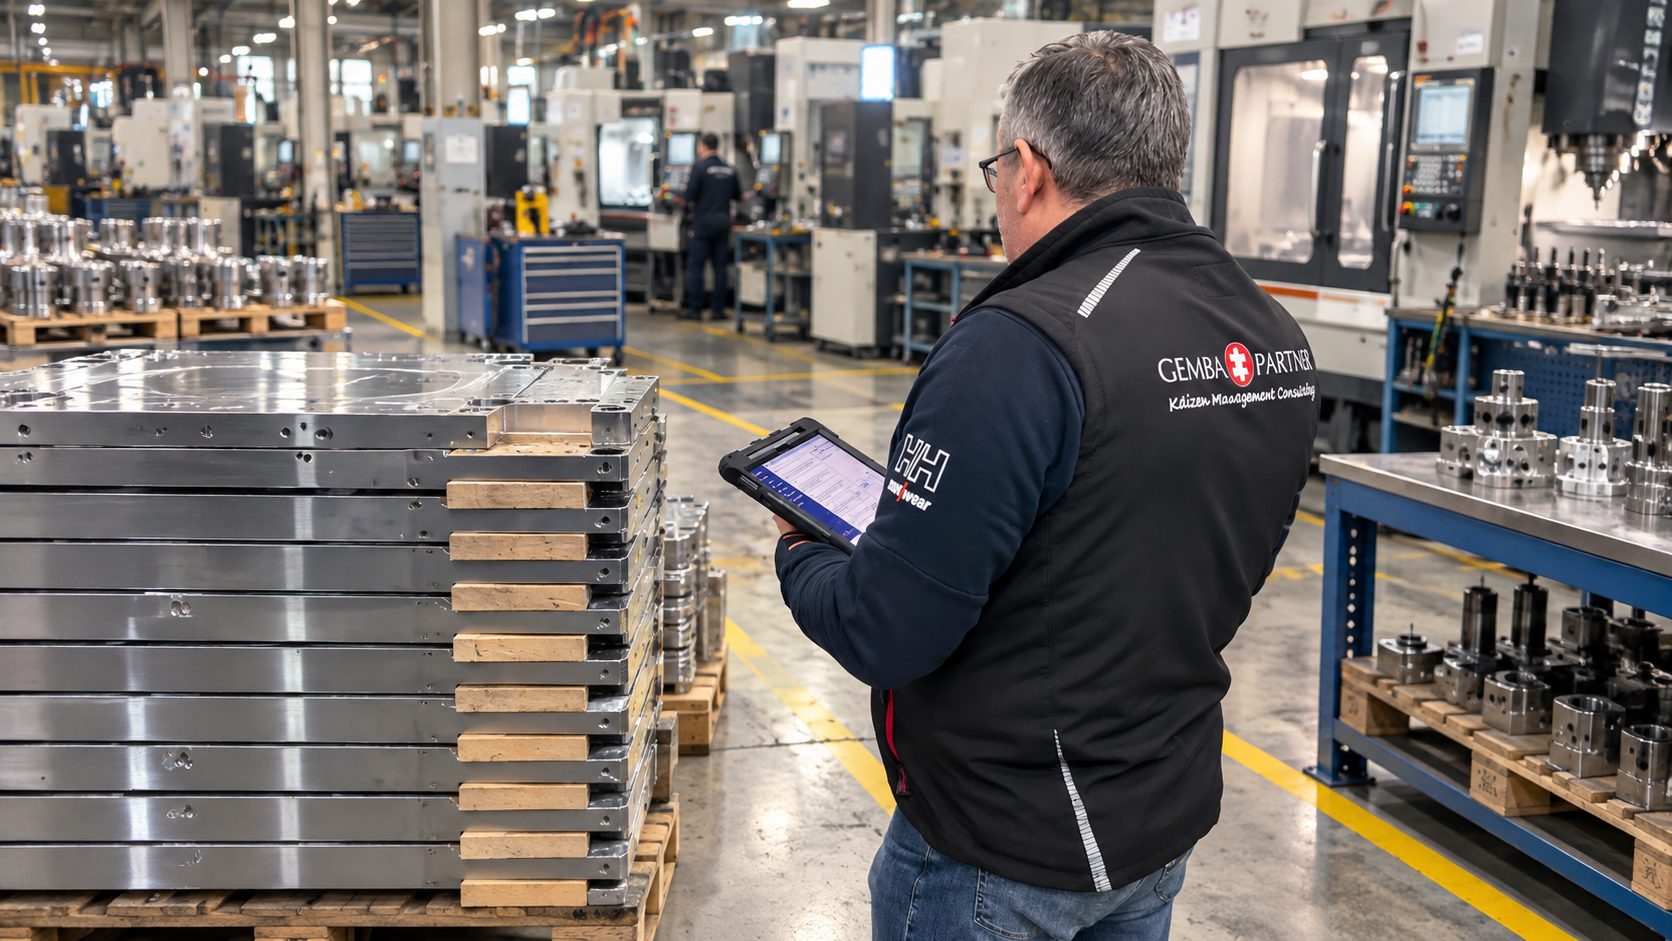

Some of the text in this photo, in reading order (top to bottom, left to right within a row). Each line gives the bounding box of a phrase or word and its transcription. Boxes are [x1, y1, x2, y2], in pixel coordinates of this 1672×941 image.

[1157, 348, 1314, 383] GEMBA PARTNER
[894, 433, 951, 493] HH
